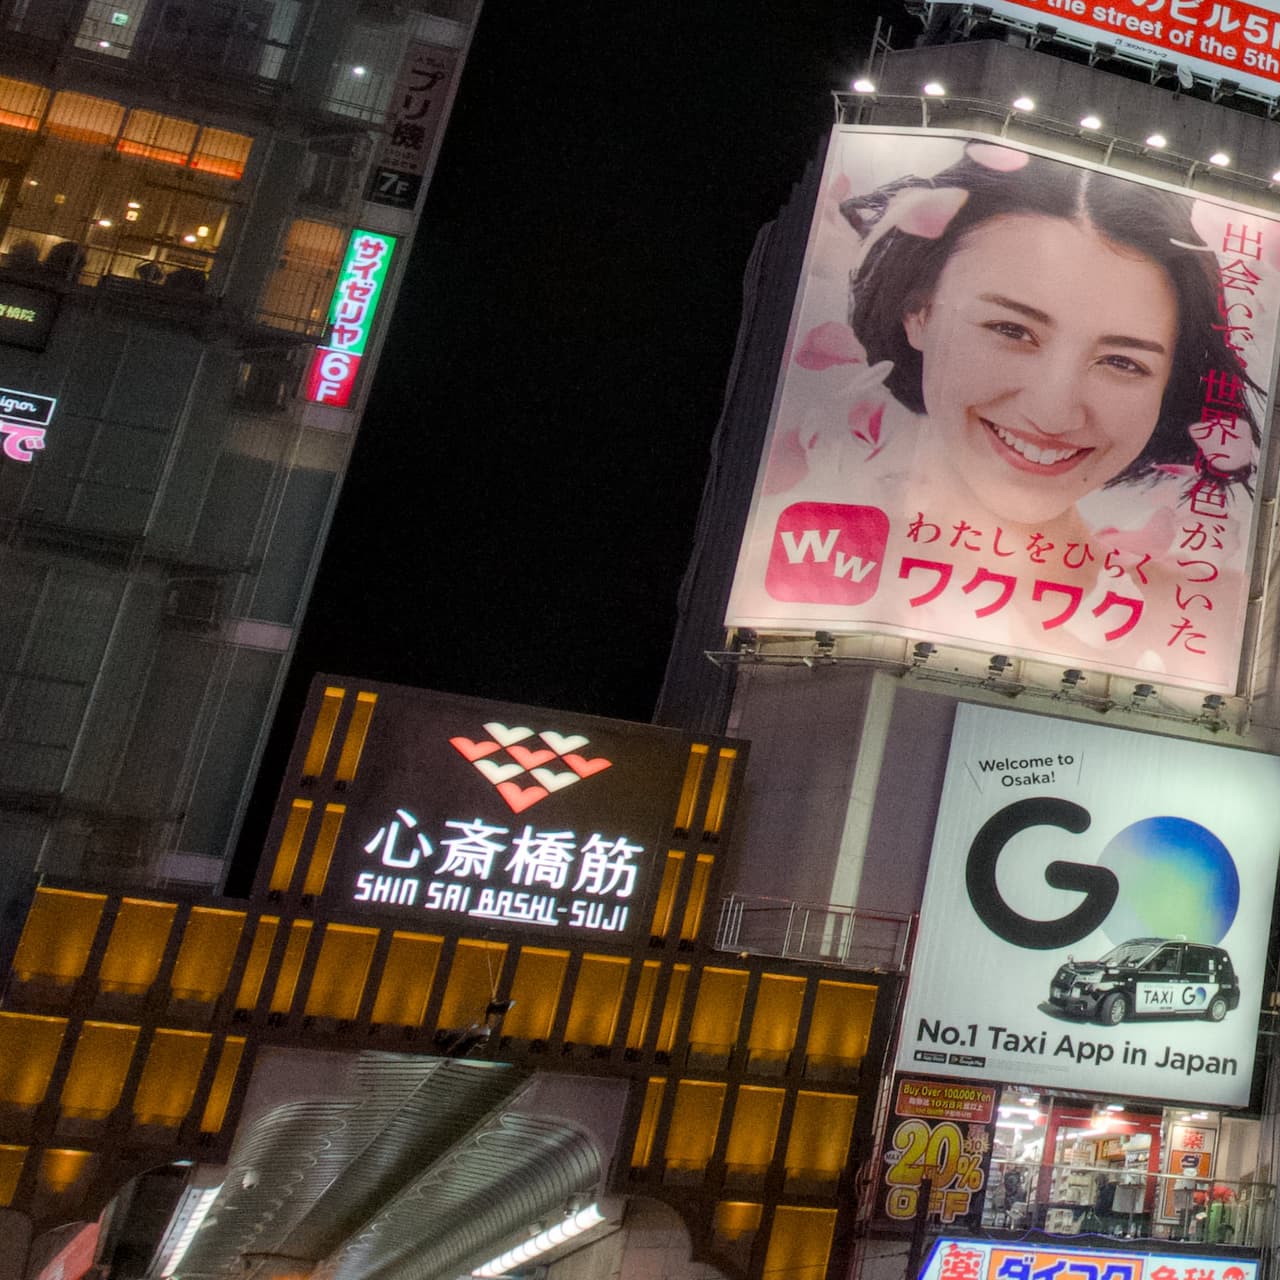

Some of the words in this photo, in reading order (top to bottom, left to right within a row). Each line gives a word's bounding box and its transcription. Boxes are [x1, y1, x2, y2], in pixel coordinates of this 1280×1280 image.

[1169, 22, 1195, 49] of
[1199, 31, 1237, 61] the
[1243, 45, 1280, 75] 5th
[379, 172, 410, 195] 7F
[331, 235, 388, 348] サイゼリヤ
[315, 354, 350, 402] 6F
[1, 421, 46, 463] で
[1166, 222, 1266, 656] 出会いで、世界に色がついた
[906, 511, 1153, 585] わたしをひらく
[896, 556, 1146, 644] ワクワク
[978, 753, 1053, 774] Welcome
[1057, 753, 1074, 768] to
[1001, 769, 1056, 788] Osaka!
[365, 809, 645, 900] 心斎橋筋
[965, 797, 1240, 951] GO
[354, 872, 420, 906] SHIN
[427, 881, 470, 914] SAI
[1144, 990, 1173, 1005] TAXI
[916, 1018, 978, 1048] No.1
[988, 1026, 1047, 1055] Taxi
[1053, 1035, 1115, 1068] App
[1122, 1042, 1148, 1065] in
[1155, 1046, 1239, 1077] Japan
[903, 1085, 921, 1096] Buy
[921, 1086, 943, 1097] Over
[976, 1091, 992, 1102] Yen
[886, 1119, 985, 1191] 20%
